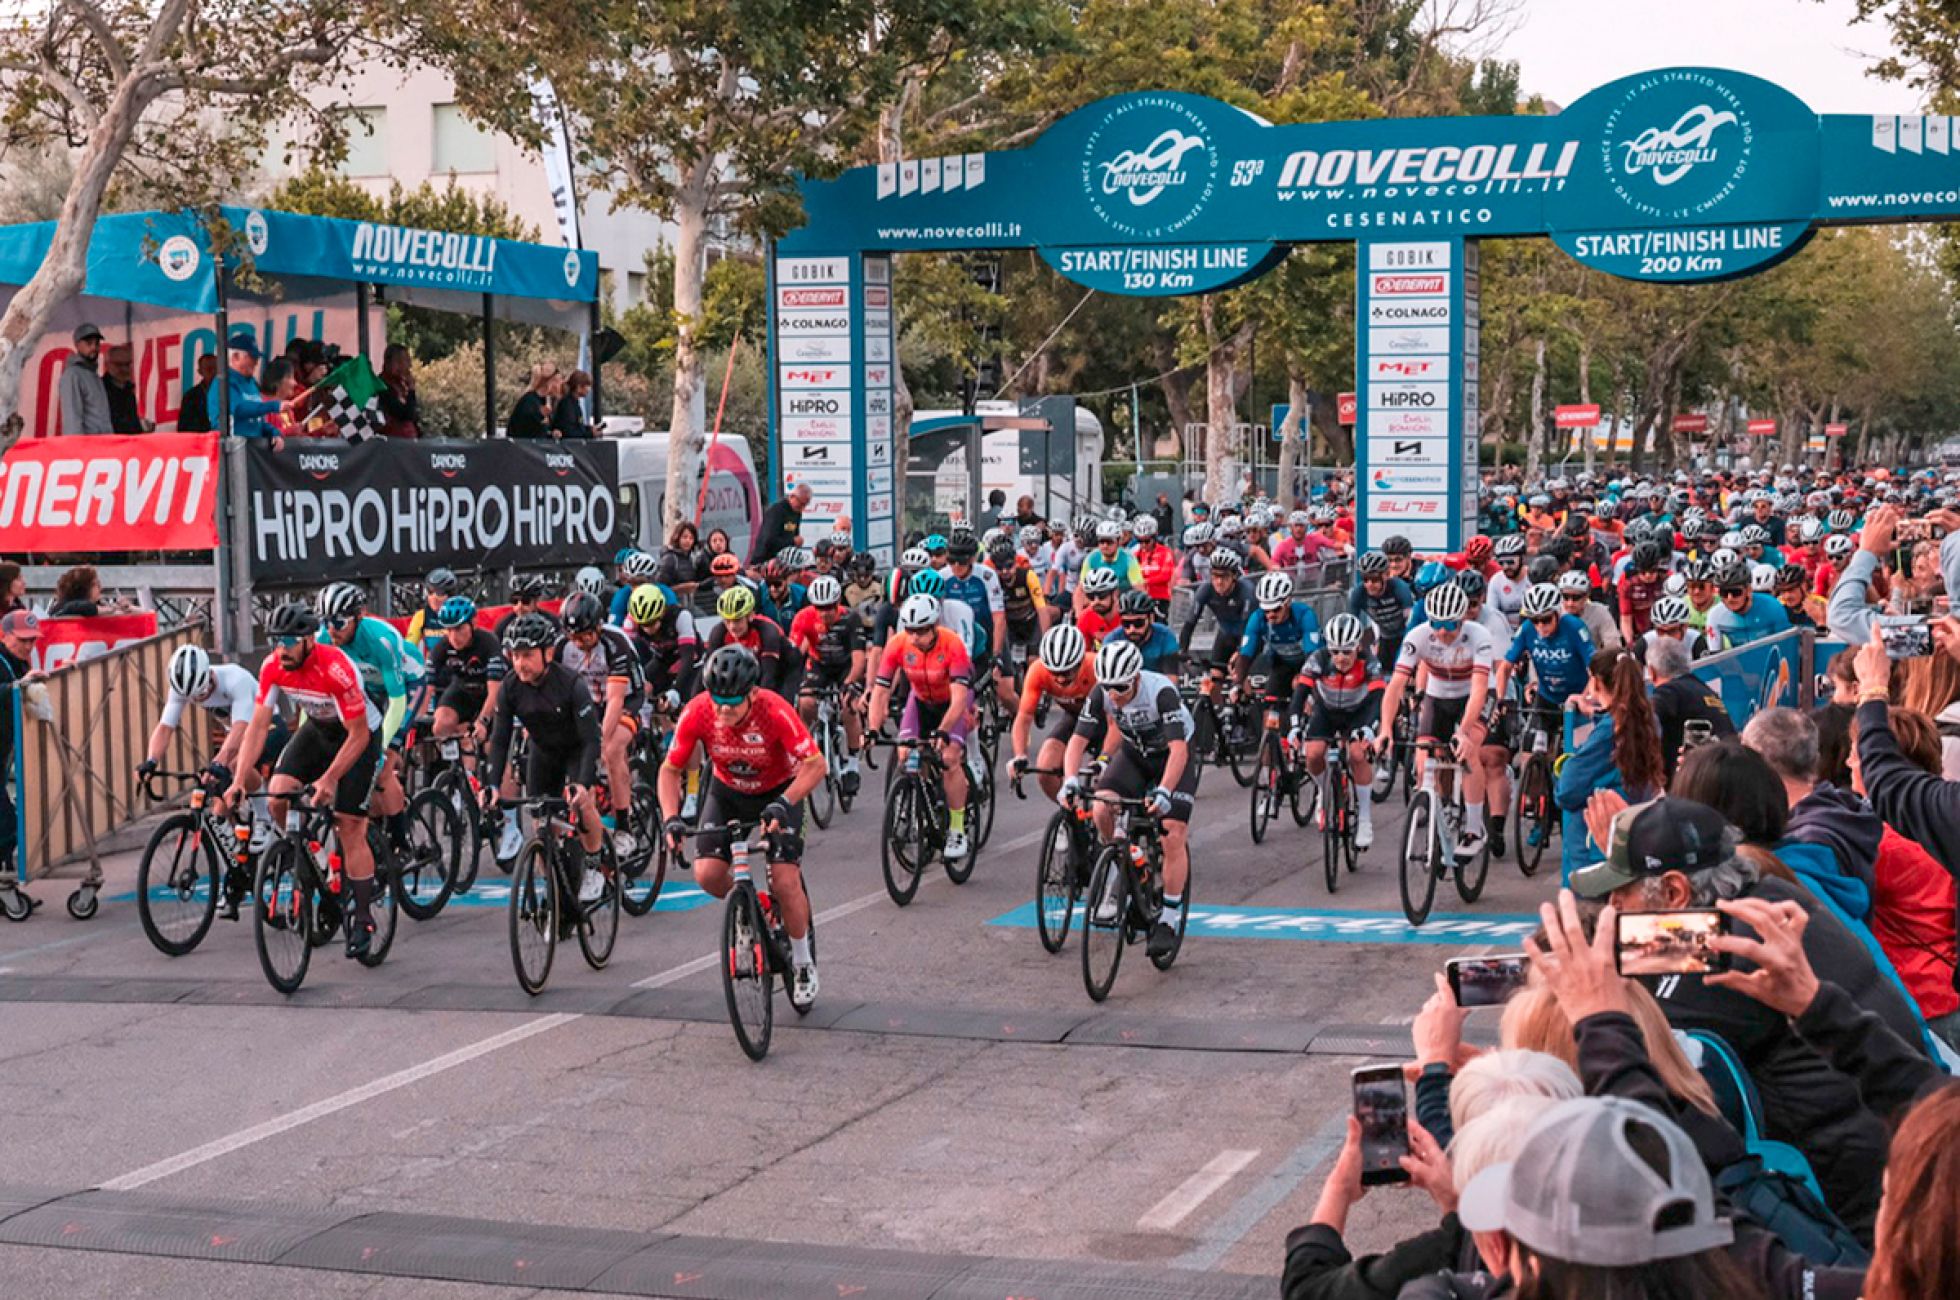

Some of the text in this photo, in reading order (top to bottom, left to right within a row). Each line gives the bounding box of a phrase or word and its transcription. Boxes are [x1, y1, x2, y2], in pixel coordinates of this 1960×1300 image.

[1625, 89, 1637, 101] IT
[1640, 76, 1660, 92] ALL
[1663, 71, 1714, 87] STARTED
[1716, 83, 1741, 108] HERE
[1116, 102, 1134, 115] ALL
[1137, 97, 1183, 112] STARTED
[1185, 110, 1207, 133] HERE
[1277, 141, 1580, 188] NOVECOLLI
[1636, 147, 1717, 166] NOVECOLLI
[1112, 171, 1186, 187] NOVECOLLI
[1277, 179, 1566, 201] www.novecolli.it
[1327, 208, 1492, 228] CESENATICO
[877, 222, 1022, 239] www.novecolli.it
[352, 223, 497, 272] NOVECOLLI
[1575, 227, 1782, 257] START/FINISH LINE
[1060, 247, 1249, 273] START/FINISH LINE
[1386, 249, 1434, 266] GOBIK
[1640, 255, 1723, 274] 200 Km
[352, 263, 493, 287] www.novecolli.it
[792, 264, 835, 279] GOBIK
[1124, 272, 1194, 289] 130 Km
[1386, 306, 1448, 318] COLNAGO
[792, 319, 848, 329] COLNAGO
[787, 370, 836, 383] MET
[1379, 362, 1432, 375] MET
[790, 399, 839, 414] HiPRO
[1381, 391, 1435, 407] HiPRO
[254, 484, 615, 561] HiPRO HiPRO HiPRO
[1533, 647, 1571, 660] MXL
